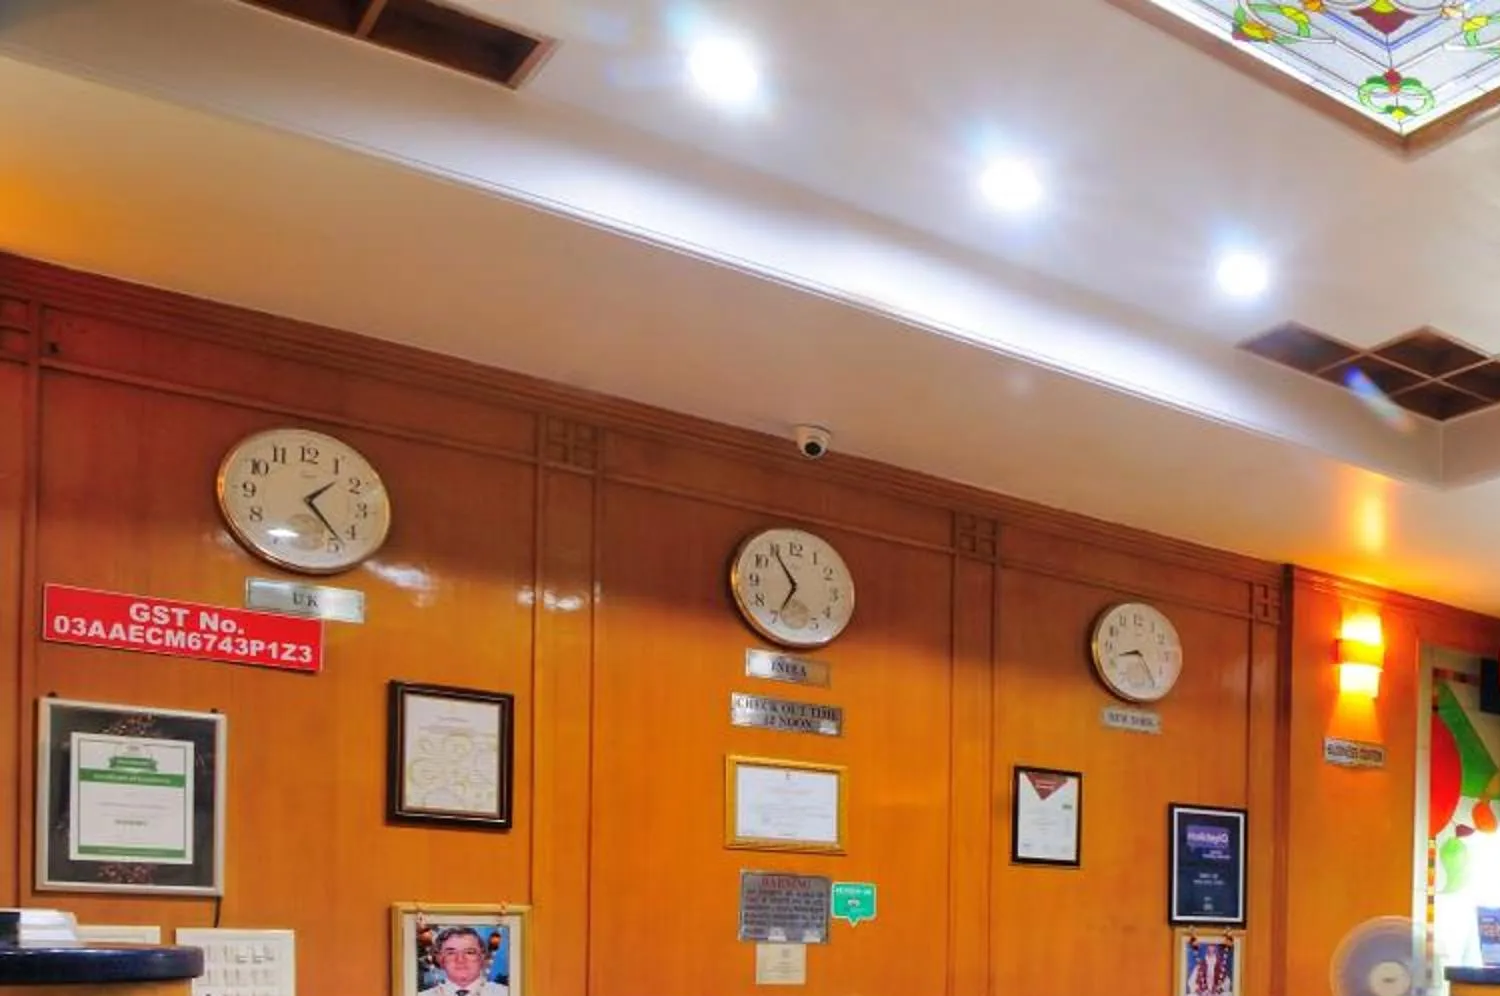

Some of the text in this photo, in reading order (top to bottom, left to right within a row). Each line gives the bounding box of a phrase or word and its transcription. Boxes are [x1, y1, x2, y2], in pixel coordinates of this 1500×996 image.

[272, 445, 287, 464] 11
[299, 446, 319, 465] 12
[250, 458, 269, 476] 10
[241, 480, 256, 498] 9
[348, 477, 361, 495] 2
[250, 506, 263, 522] 8
[356, 502, 368, 519] 3
[345, 524, 356, 540] 4
[789, 542, 803, 557] 12
[755, 553, 769, 568] 10
[749, 572, 759, 586] 9
[822, 566, 834, 581] 2
[292, 591, 318, 607] UK
[129, 602, 245, 635] GST No.
[769, 609, 779, 624] 7
[53, 615, 313, 663] 03AAECM6743P1Z3
